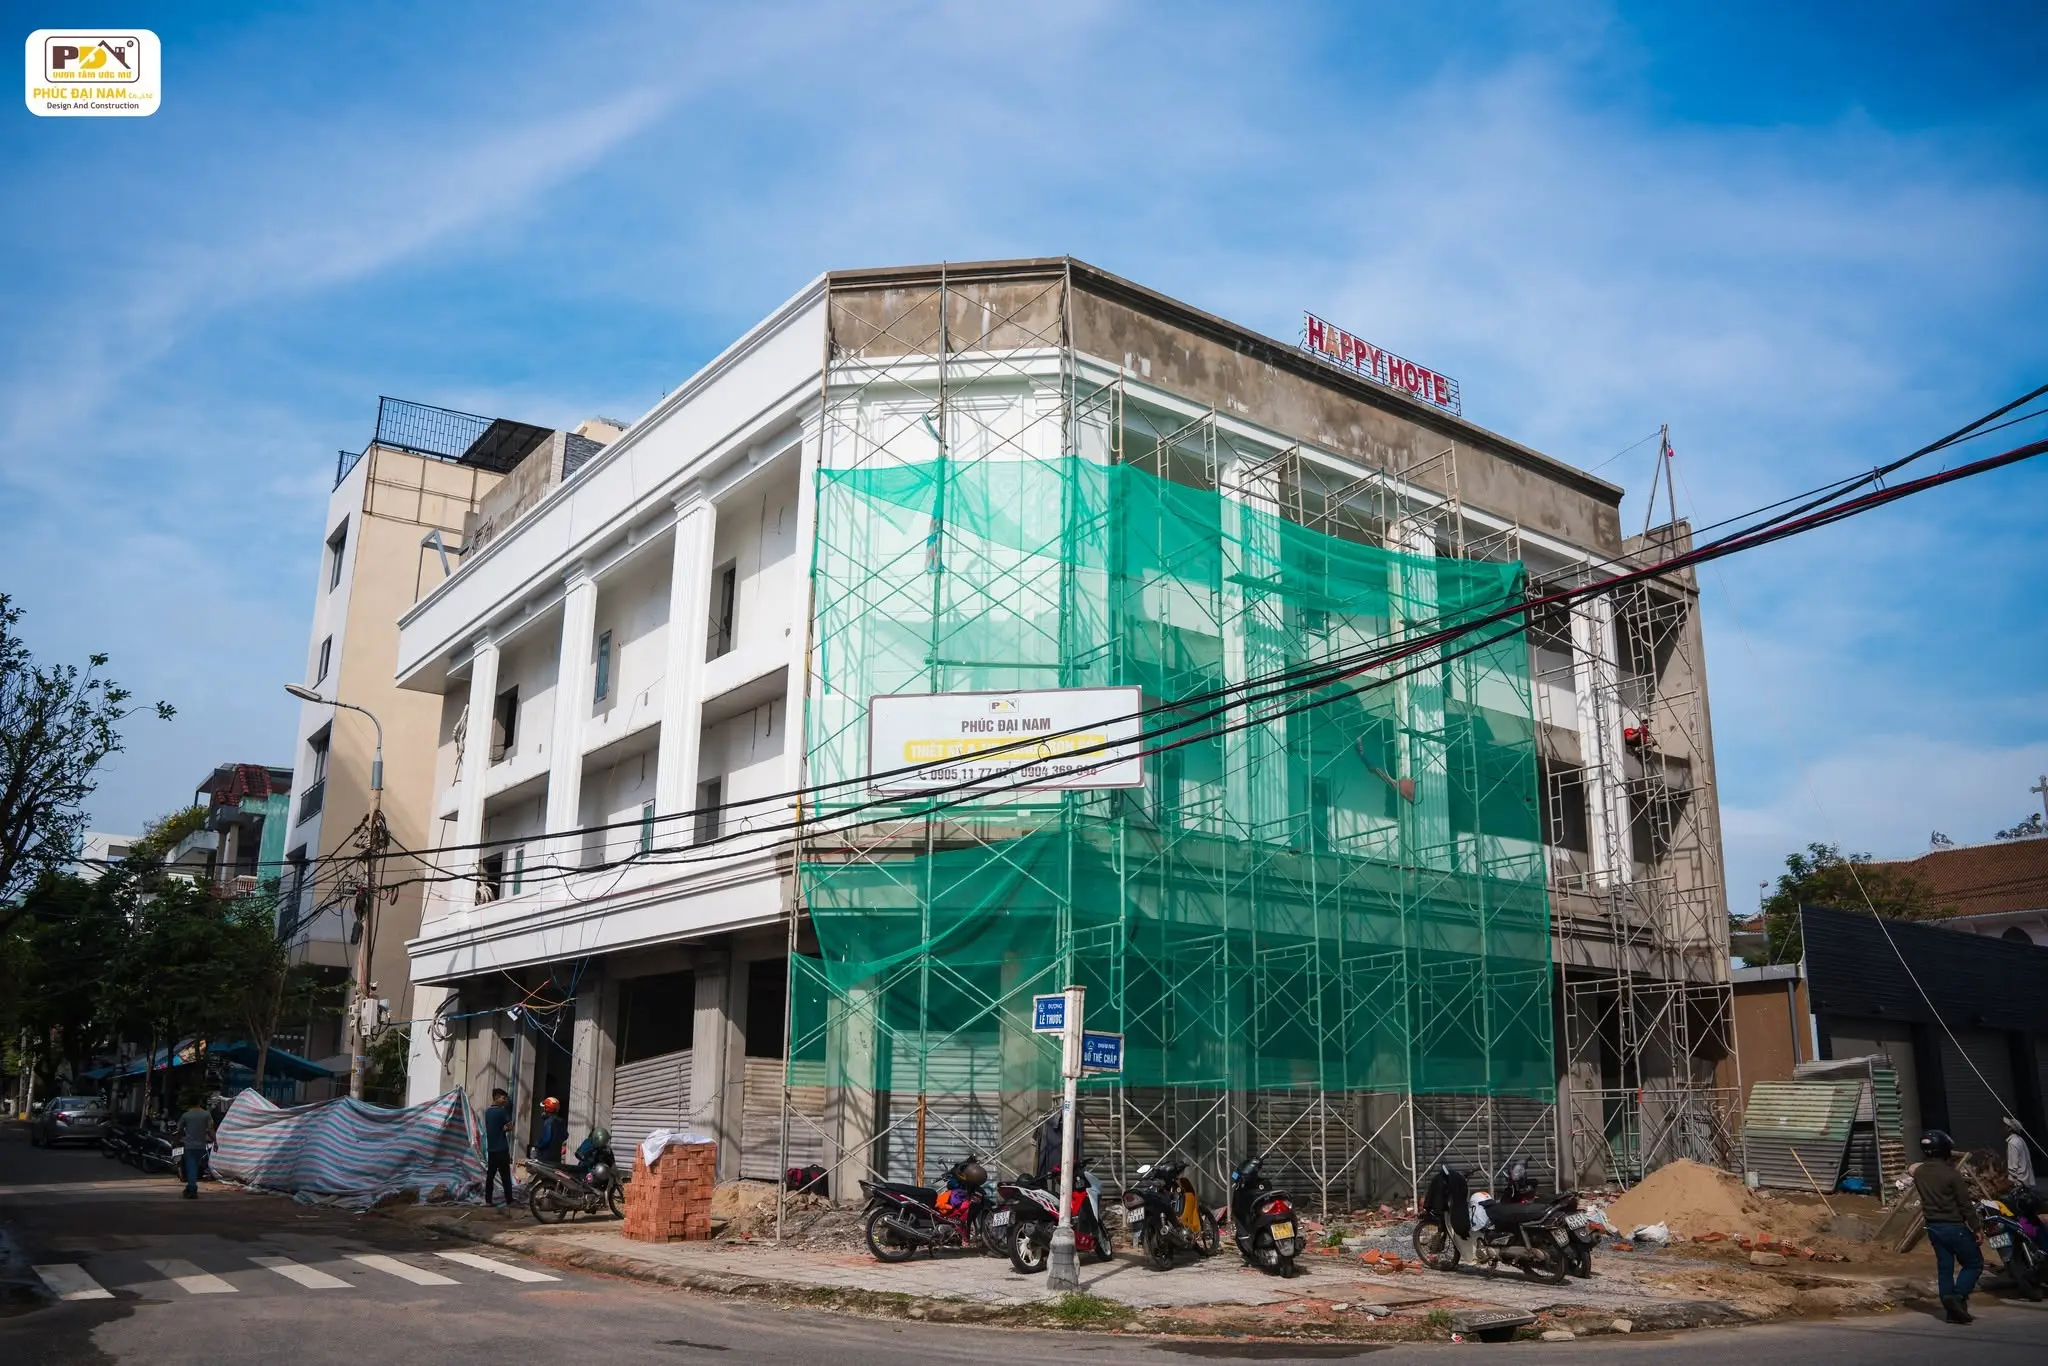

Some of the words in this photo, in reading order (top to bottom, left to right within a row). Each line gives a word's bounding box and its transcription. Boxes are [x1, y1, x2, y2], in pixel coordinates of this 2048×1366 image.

[1307, 316, 1382, 377] HAPPY
[1387, 354, 1449, 407] HOTE
[961, 717, 995, 733] PHÚC
[997, 718, 1019, 734] ĐẠI
[1022, 717, 1051, 731] NAM
[930, 768, 958, 781] 0905
[961, 768, 974, 780] 11
[1020, 766, 1048, 778] 0904
